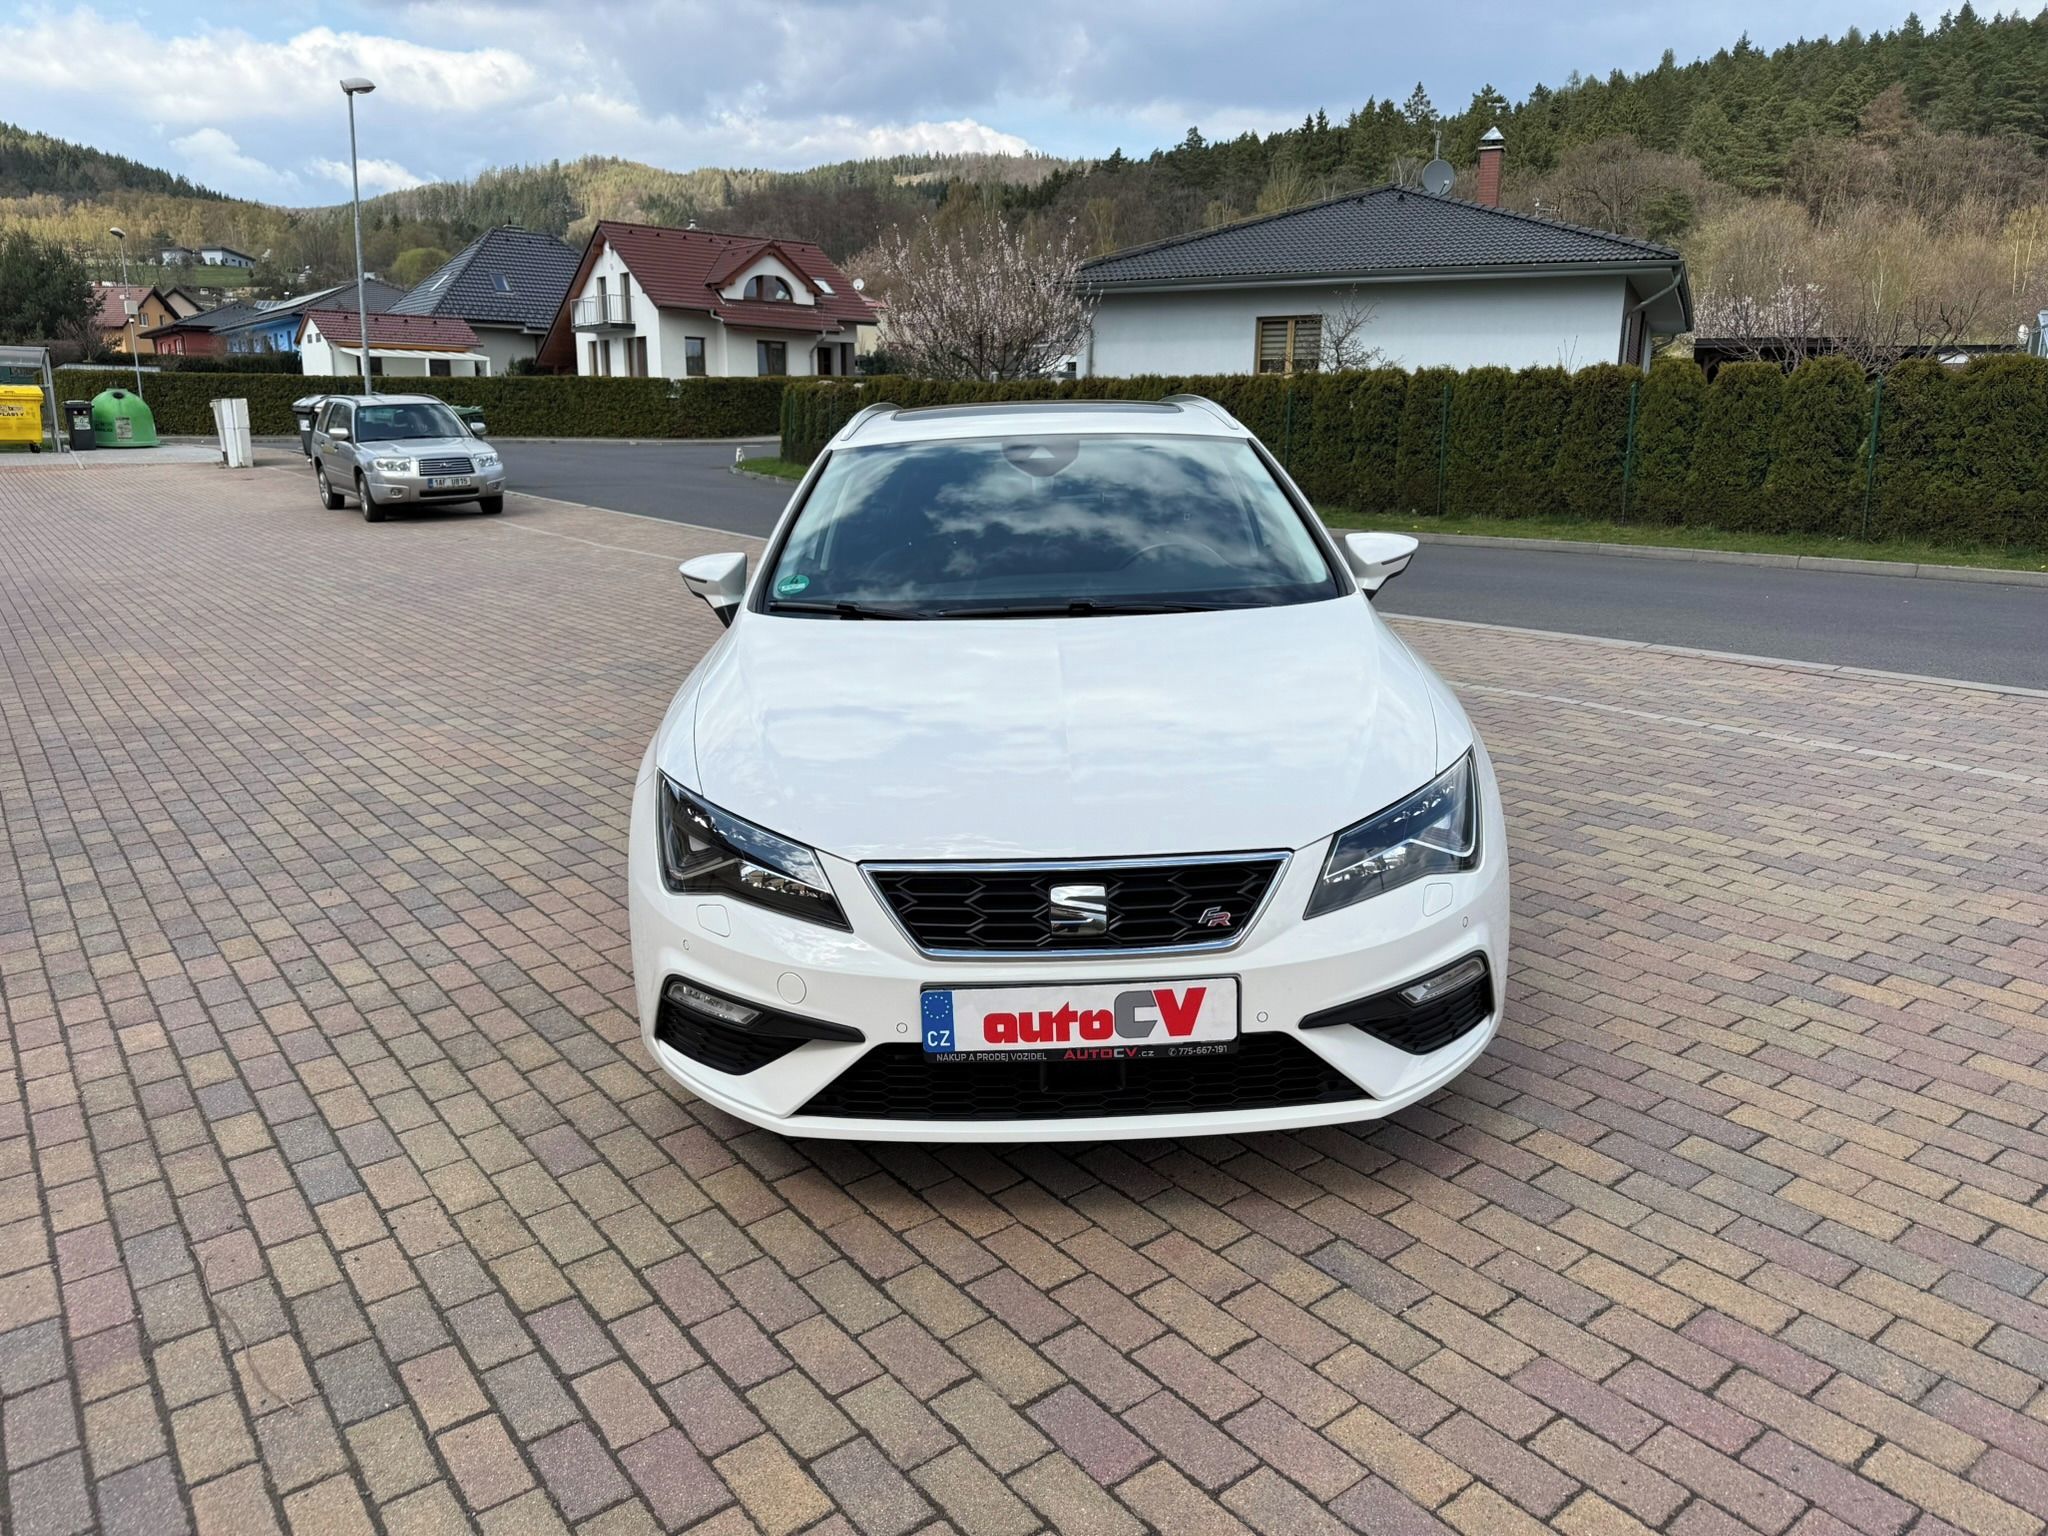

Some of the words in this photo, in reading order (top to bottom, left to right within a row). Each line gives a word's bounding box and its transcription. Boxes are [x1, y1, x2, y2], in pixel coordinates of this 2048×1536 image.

[983, 987, 1207, 1044] autoCV
[927, 1030, 950, 1047] CZ
[968, 1053, 975, 1061] A
[976, 1053, 1009, 1062] PRODEJ
[1010, 1052, 1047, 1061] VOZIDEL
